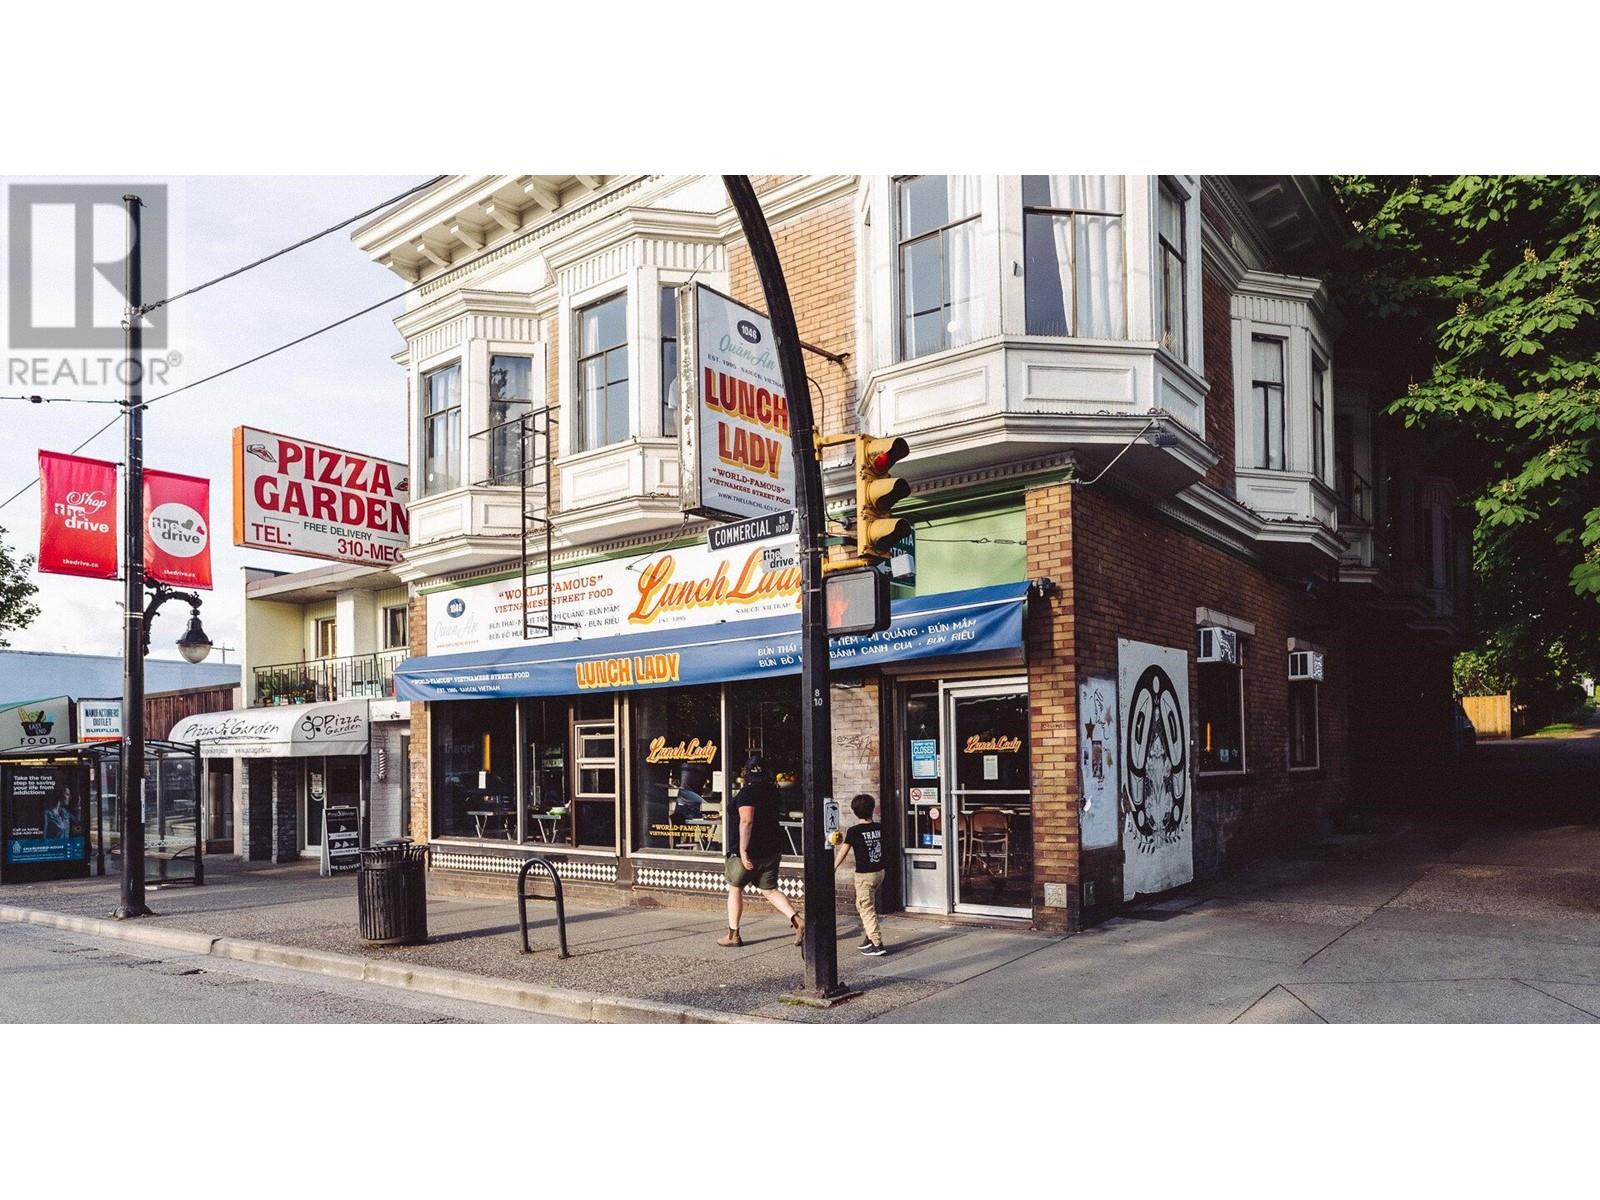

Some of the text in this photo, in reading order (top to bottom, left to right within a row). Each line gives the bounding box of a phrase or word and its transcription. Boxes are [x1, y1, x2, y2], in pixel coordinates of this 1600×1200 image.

[705, 367, 790, 436] LUNCH
[718, 421, 781, 479] LADY
[277, 440, 393, 498] PIZZA
[708, 477, 791, 505] VIETNAMESE STREET FOOD
[55, 503, 86, 517] the
[66, 490, 107, 513] Shop
[254, 475, 409, 536] GARDEN
[64, 517, 110, 533] drive
[152, 517, 179, 530] the
[304, 522, 372, 541] FREE DELIVERY
[714, 515, 786, 546] COMMERCIAL DR
[775, 523, 789, 533] 1000
[161, 529, 200, 544] drive
[252, 523, 292, 545] TEL:
[763, 548, 781, 560] the
[769, 557, 794, 568] drive
[62, 558, 99, 568] thedrive.ca
[163, 569, 196, 578] thedrive.ca
[551, 593, 586, 606] STREET
[589, 588, 614, 600] FOOD
[628, 555, 733, 625] Lunch
[757, 645, 775, 657] BÚN
[928, 621, 949, 634] BÚN
[758, 657, 776, 668] BÚN
[781, 654, 795, 665] BÒ
[829, 646, 856, 659] BÁNH
[861, 645, 888, 656] CANH
[894, 641, 912, 651] CUA
[454, 674, 490, 683] VIETNAMESE
[490, 672, 513, 681] STREET
[514, 671, 530, 679] FOOD
[575, 652, 681, 690] LUNCH LADY
[477, 684, 500, 693] VIETNAM
[814, 689, 820, 697] 8
[813, 698, 823, 706] 10
[92, 718, 111, 726] OUTLET
[183, 718, 279, 738] Pizza Garden
[324, 714, 362, 728] Pizza
[325, 723, 361, 735] Garden
[646, 736, 717, 764] Lunch Lady
[914, 745, 934, 754] CLOSED
[964, 734, 1021, 753] Lunch Lady
